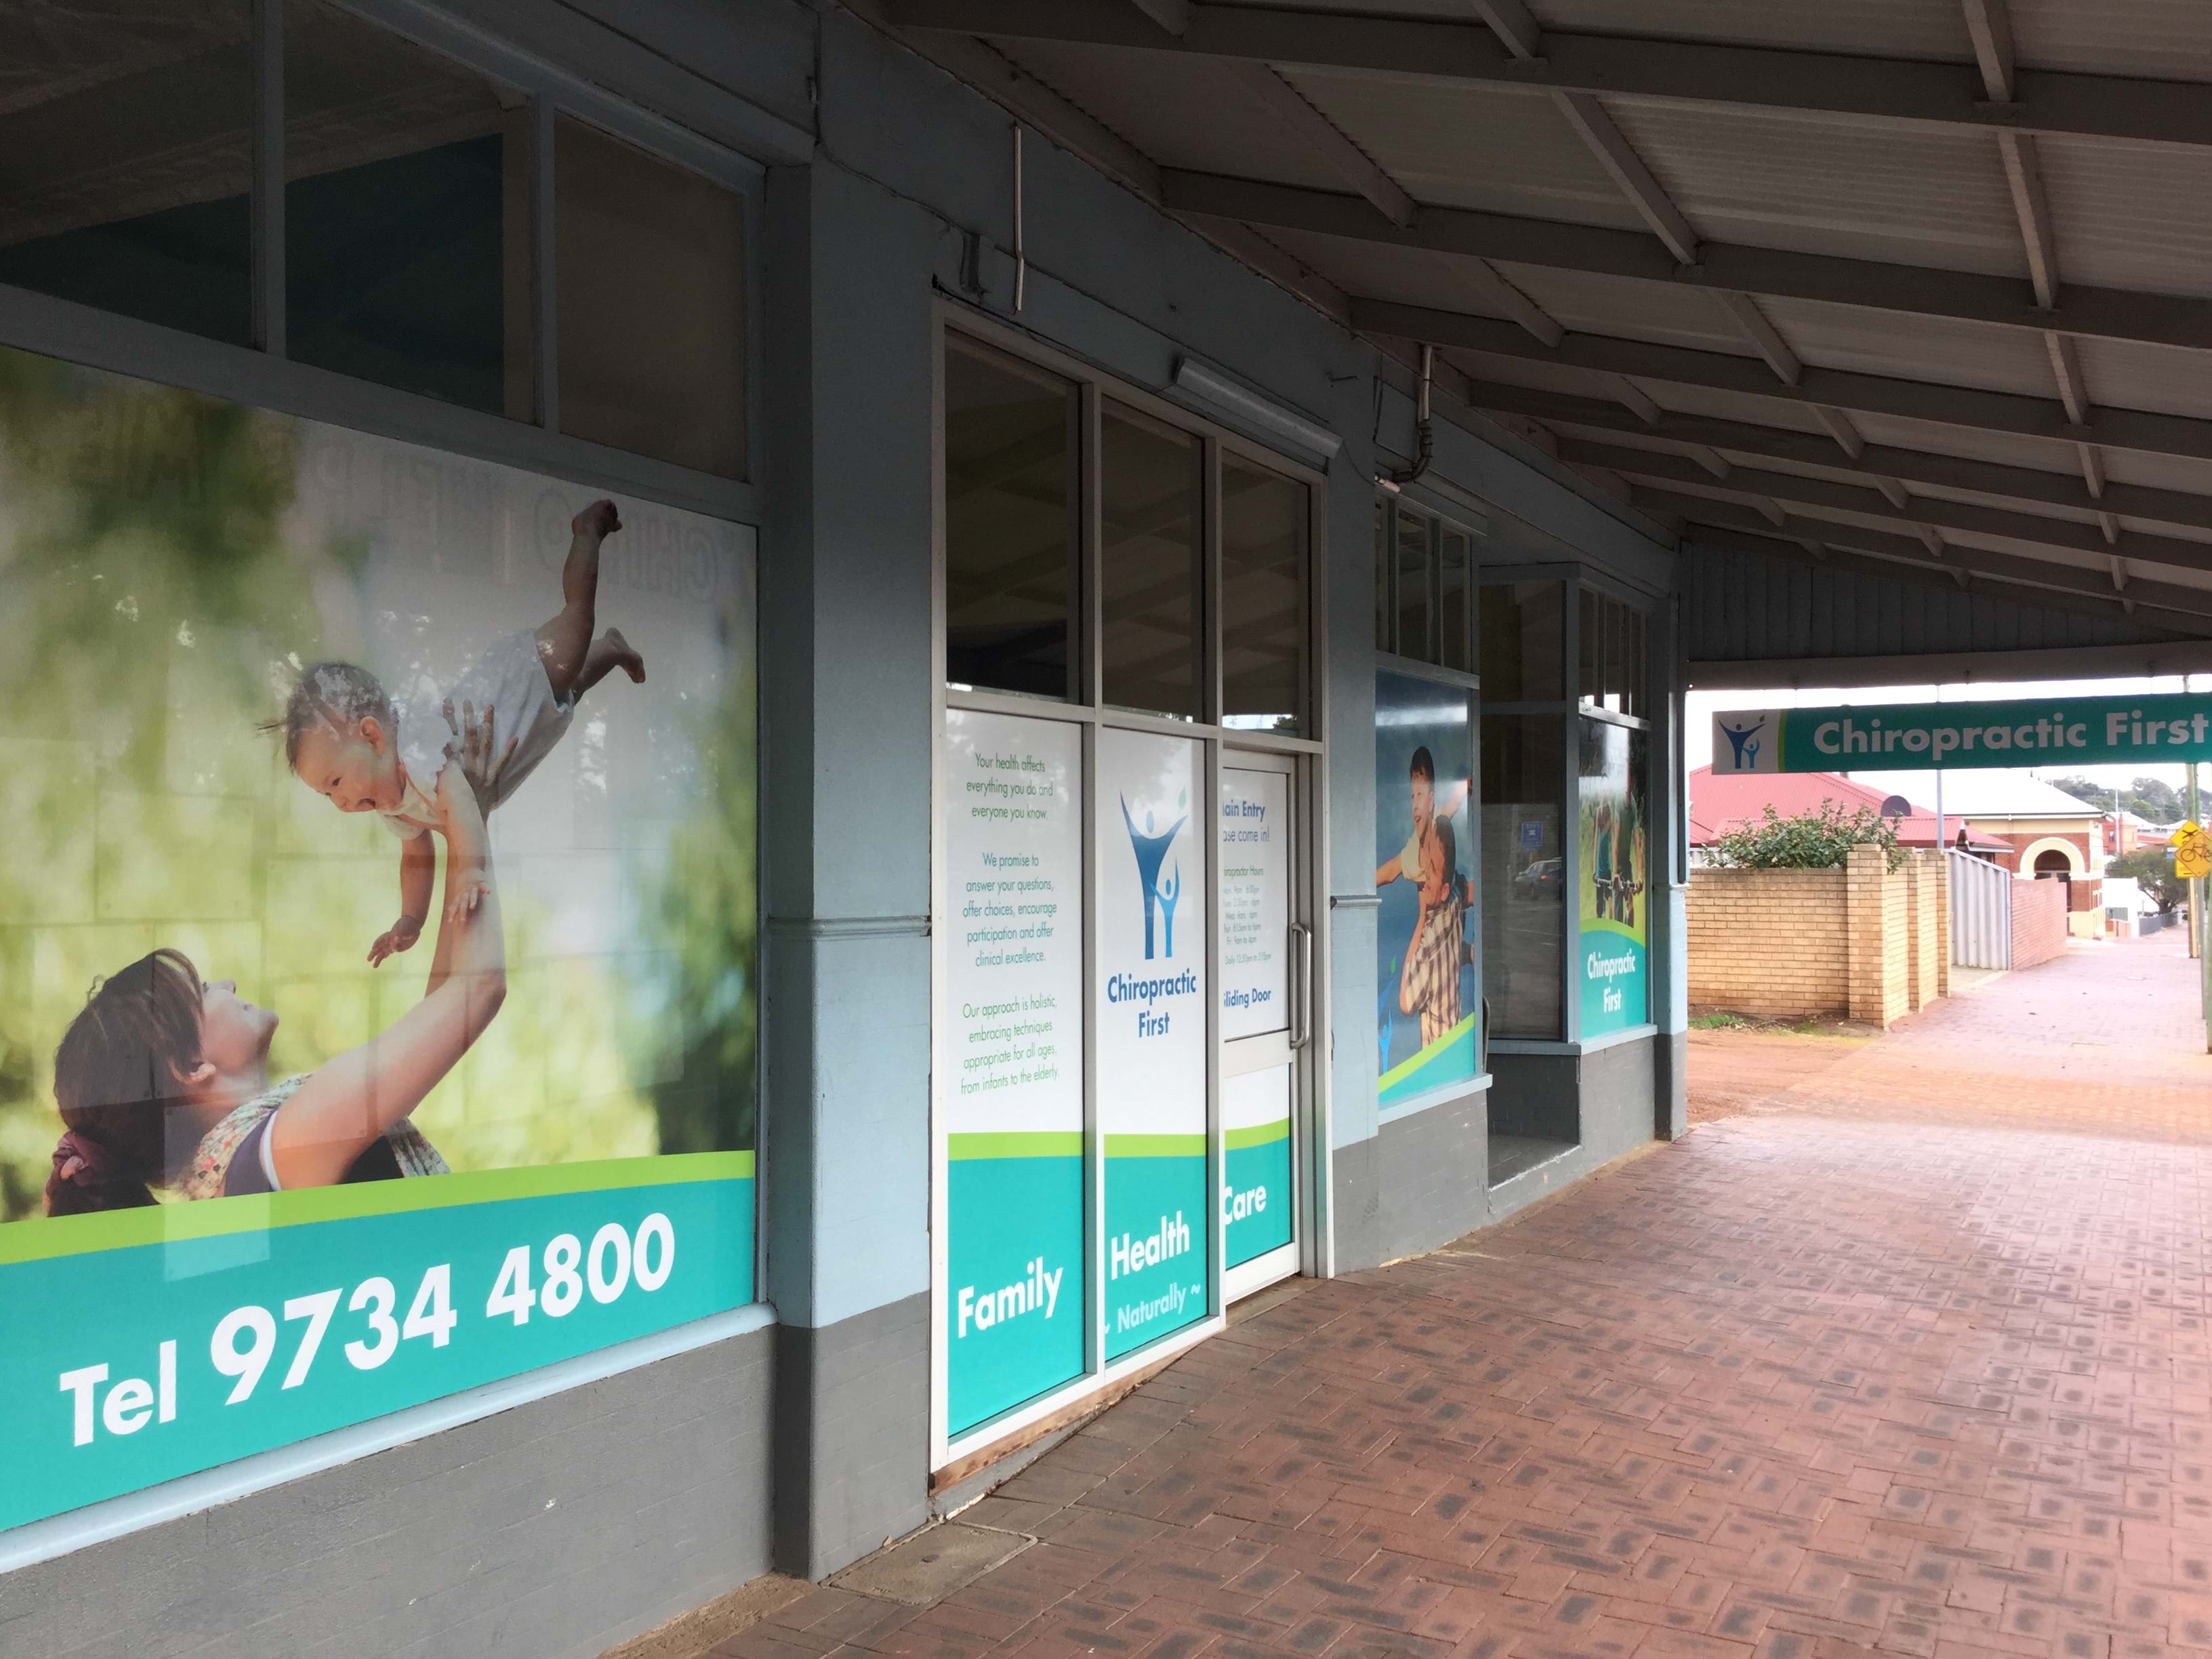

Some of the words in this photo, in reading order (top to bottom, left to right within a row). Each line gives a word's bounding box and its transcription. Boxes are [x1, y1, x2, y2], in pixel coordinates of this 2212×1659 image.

[1814, 712, 2087, 760] Chiropractic
[2106, 709, 2209, 745] First
[975, 752, 994, 769] Your
[996, 753, 1019, 771] health
[1021, 755, 1046, 773] affects
[966, 777, 1008, 798] everything
[1010, 783, 1025, 798] you
[1027, 780, 1037, 796] do
[1039, 781, 1053, 797] and
[971, 806, 1008, 822] everyone
[1010, 808, 1025, 823] you
[1027, 802, 1048, 819] know.
[1223, 798, 1240, 817] ain
[1242, 800, 1266, 823] Entry
[1237, 830, 1258, 842] come
[983, 852, 998, 867] We
[999, 853, 1030, 872] promise
[1031, 854, 1040, 867] to
[966, 881, 996, 893] answer
[998, 880, 1016, 896] your
[1017, 876, 1054, 895] questions,
[962, 900, 982, 918] offer
[984, 900, 1016, 918] choices,
[1018, 903, 1057, 918] encourage
[967, 926, 1017, 947] participation
[1019, 922, 1035, 939] and
[1036, 921, 1054, 938] offer
[975, 948, 1004, 967] clinical
[1006, 947, 1046, 964] excellence.
[1587, 947, 1636, 983] Chiropractic
[1107, 968, 1197, 1006] Chiropractic
[1252, 988, 1272, 1003] Door
[1603, 987, 1622, 1013] First
[962, 1003, 980, 1019] Our
[982, 996, 1020, 1019] approach
[1022, 998, 1029, 1010] is
[1030, 993, 1058, 1010] holistic,
[968, 1024, 1012, 1042] embracing
[1014, 1019, 1053, 1038] techniques
[1139, 1010, 1170, 1038] First
[964, 1048, 1012, 1073] appropriate
[1013, 1044, 1025, 1061] for
[1026, 1042, 1036, 1059] all
[961, 1078, 980, 1095] from
[983, 1073, 1009, 1090] infants
[1010, 1073, 1019, 1085] to
[1020, 1067, 1032, 1084] the
[957, 1256, 1064, 1339] Family
[1110, 1210, 1191, 1281] Health
[1224, 1185, 1267, 1225] Care
[1117, 1282, 1187, 1334] Naturally
[60, 1338, 177, 1447] Tel
[209, 1263, 458, 1406] 9734
[485, 1212, 676, 1327] 4800
